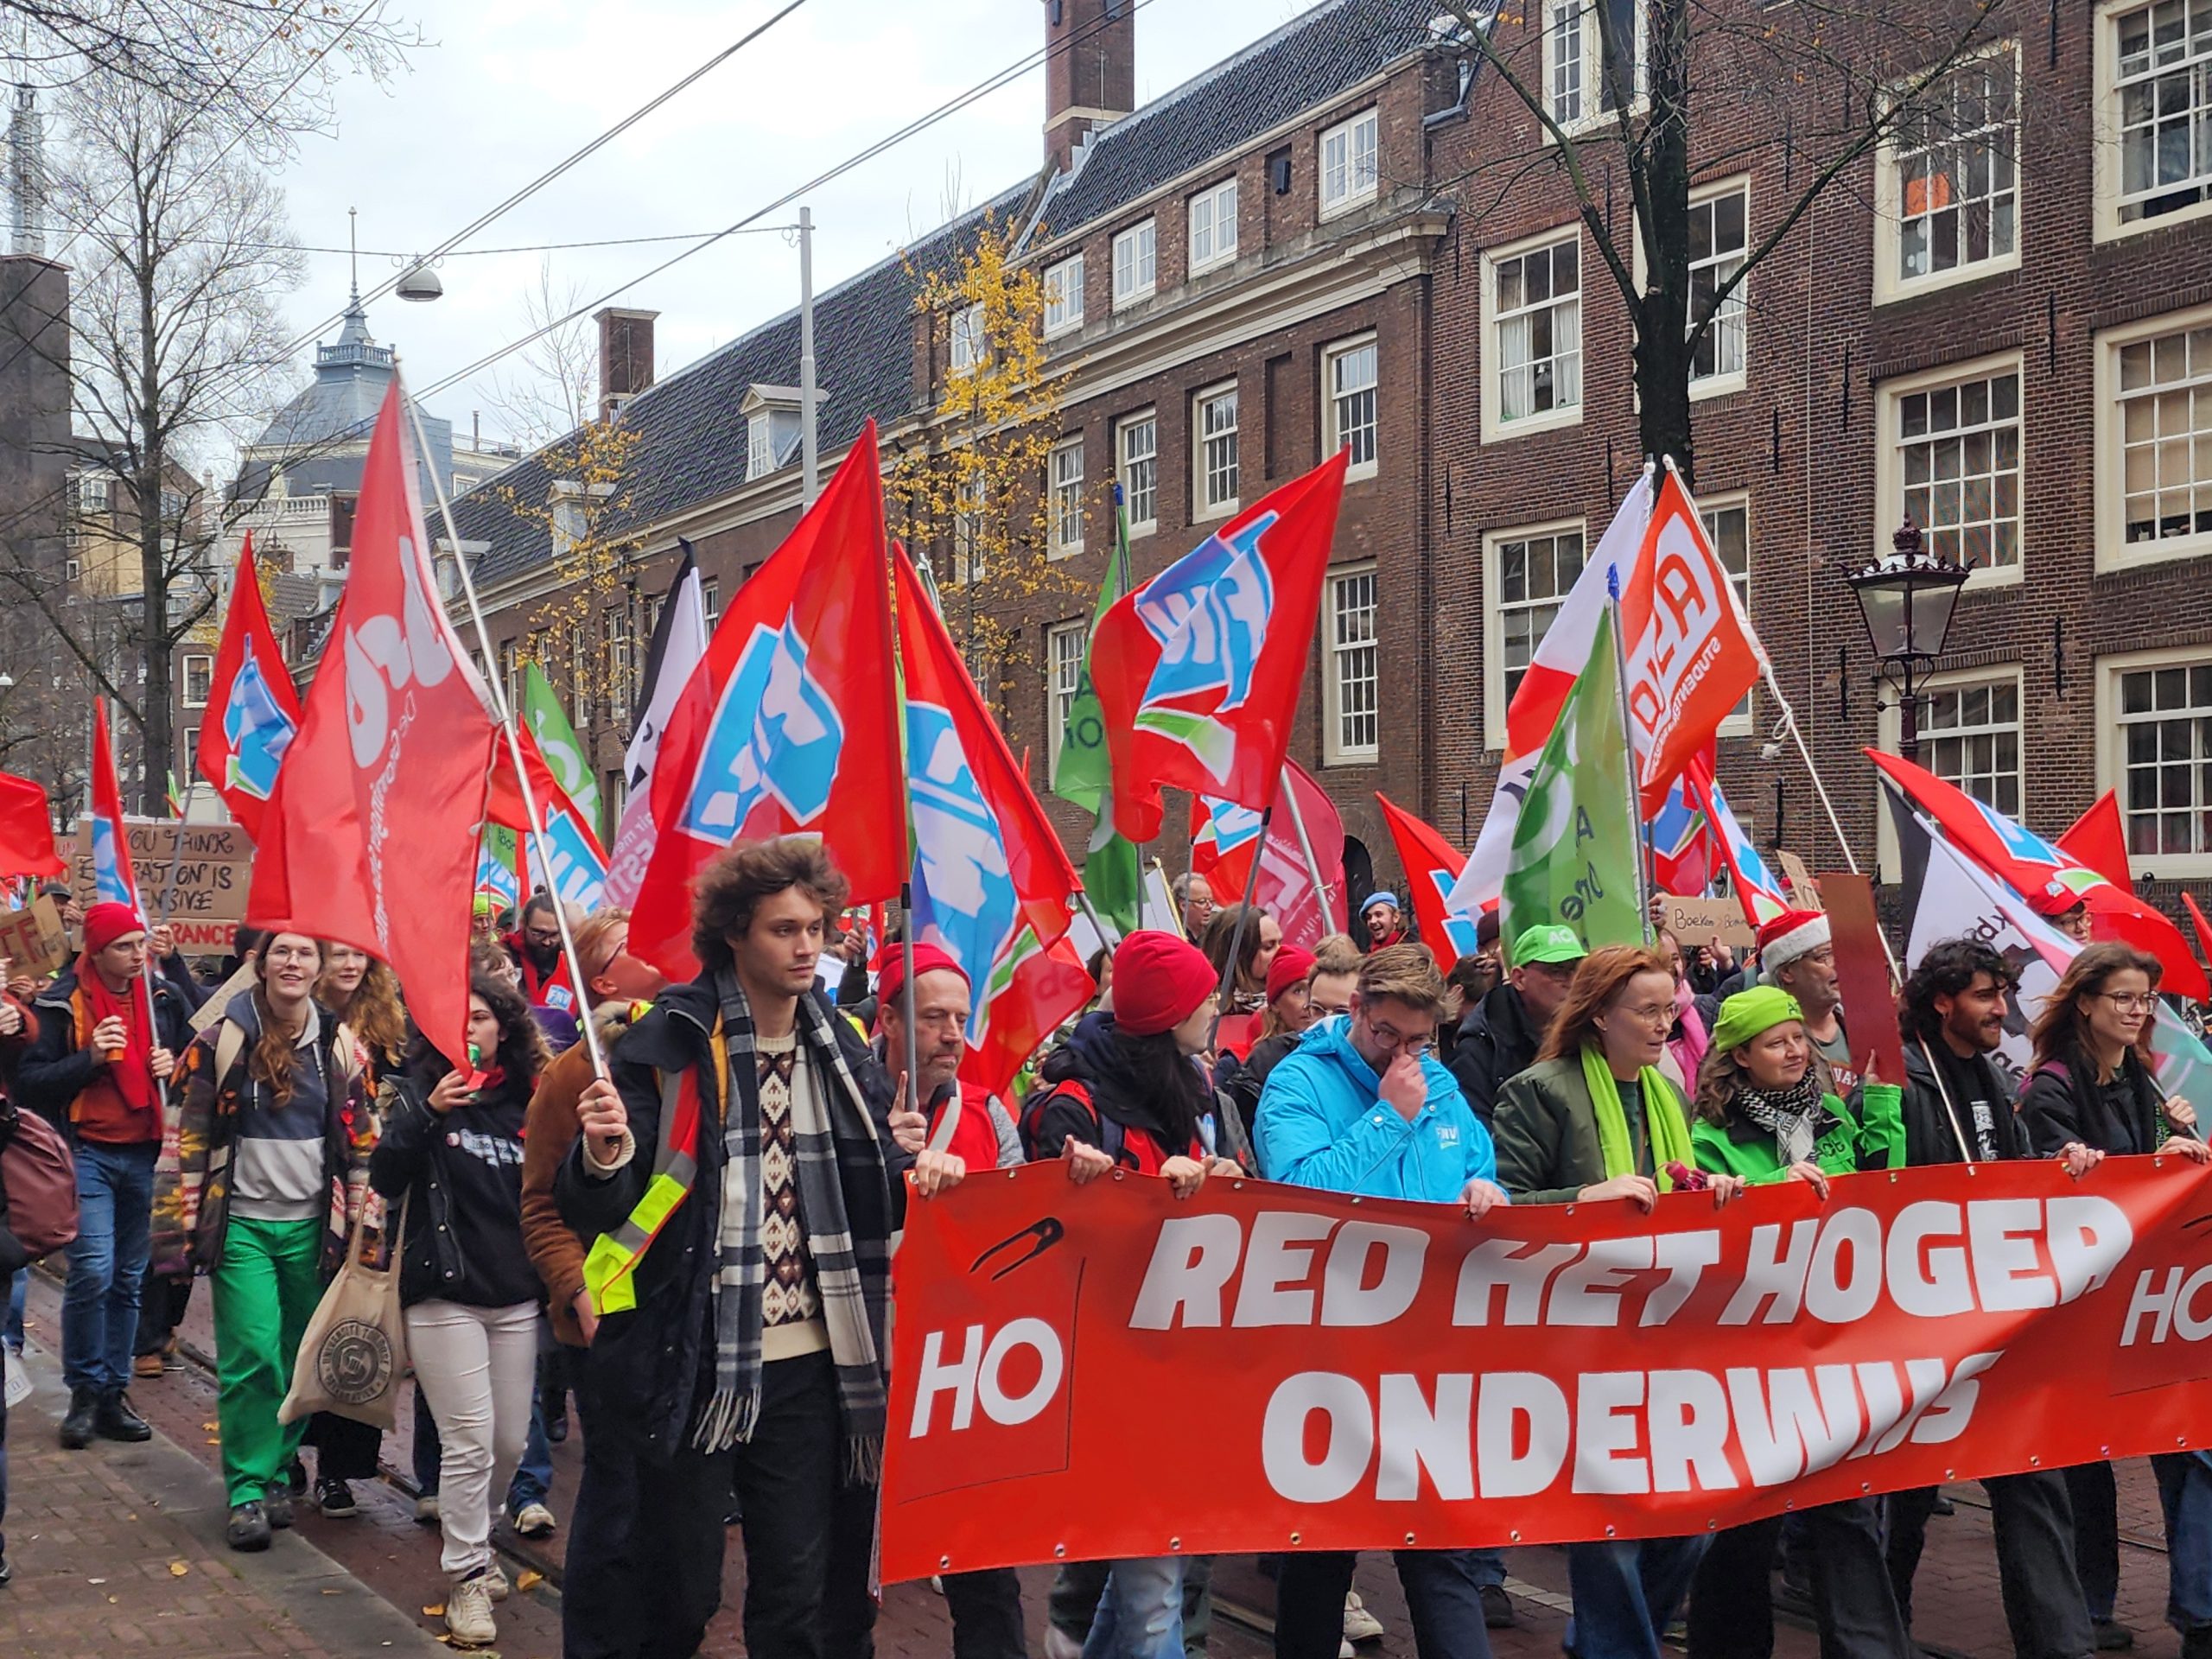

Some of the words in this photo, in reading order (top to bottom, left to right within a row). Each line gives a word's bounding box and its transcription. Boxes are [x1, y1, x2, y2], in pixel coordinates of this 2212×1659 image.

[212, 866, 232, 890] IS
[1128, 1211, 1430, 1330] RED
[1452, 1230, 1720, 1329] HET
[1718, 1195, 2133, 1325] HOGER
[909, 1317, 1064, 1440] HO
[1262, 1349, 2005, 1503] ONDERWIJS
